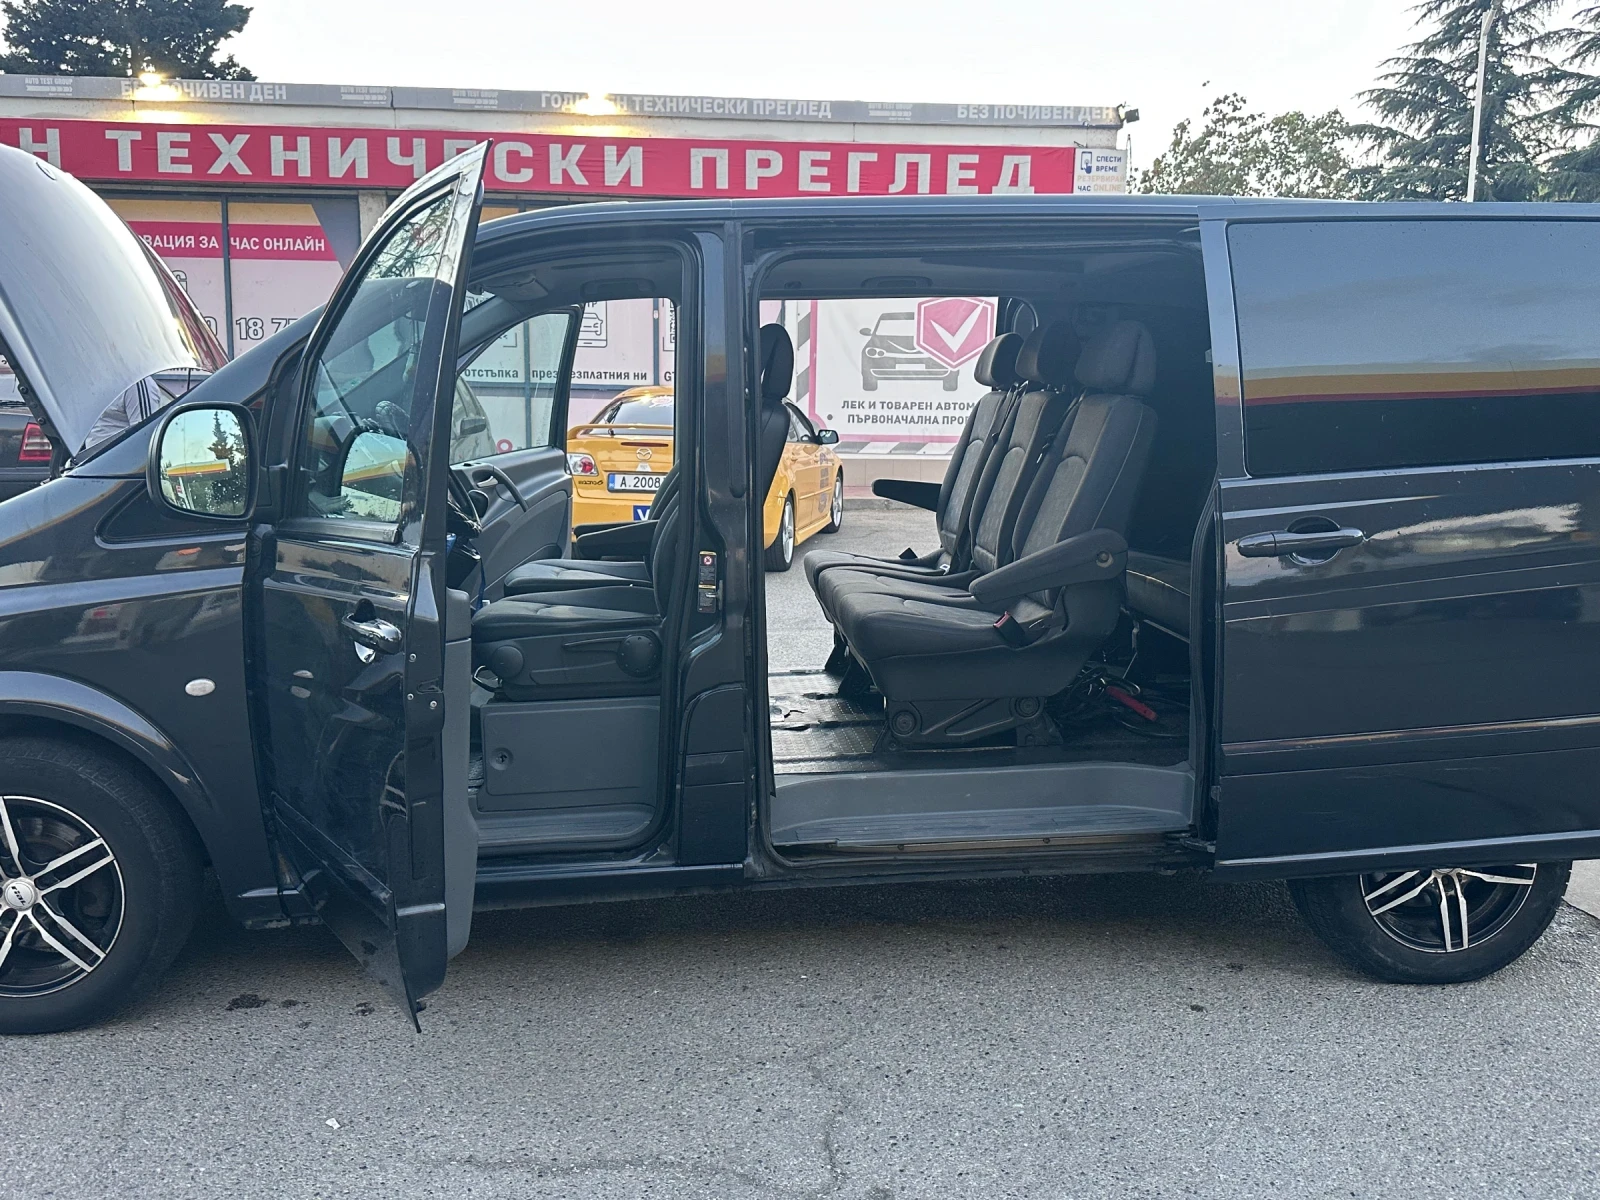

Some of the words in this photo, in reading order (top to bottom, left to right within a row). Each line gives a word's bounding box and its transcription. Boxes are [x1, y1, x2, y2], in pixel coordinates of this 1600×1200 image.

[168, 81, 245, 99] ОЧИВЕН
[249, 84, 287, 102] ДЕН
[632, 96, 748, 115] ТЕХНИЧЕСКИ
[752, 100, 832, 119] ПРЕГЛЕД
[957, 104, 989, 119] БЕЗ
[993, 105, 1074, 120] ПОЧИВЕН
[1077, 107, 1113, 121] ДЕН
[1096, 155, 1122, 163] СПЕСТИ
[690, 148, 1035, 194] ПРЕГЛЕД
[140, 234, 195, 250] ВАЦИЯ
[199, 236, 219, 249] ЗА
[230, 237, 260, 250] ЧАС
[263, 236, 325, 251] ОНЛАЙН
[236, 317, 264, 340] 18
[464, 368, 519, 379] отстъпка
[571, 370, 630, 381] езплатния
[841, 400, 865, 409] ЛЕК
[868, 401, 876, 409] И
[879, 401, 933, 411] ТОВАРЕН
[847, 414, 940, 425] ПЪРВОНАЧАЛНА
